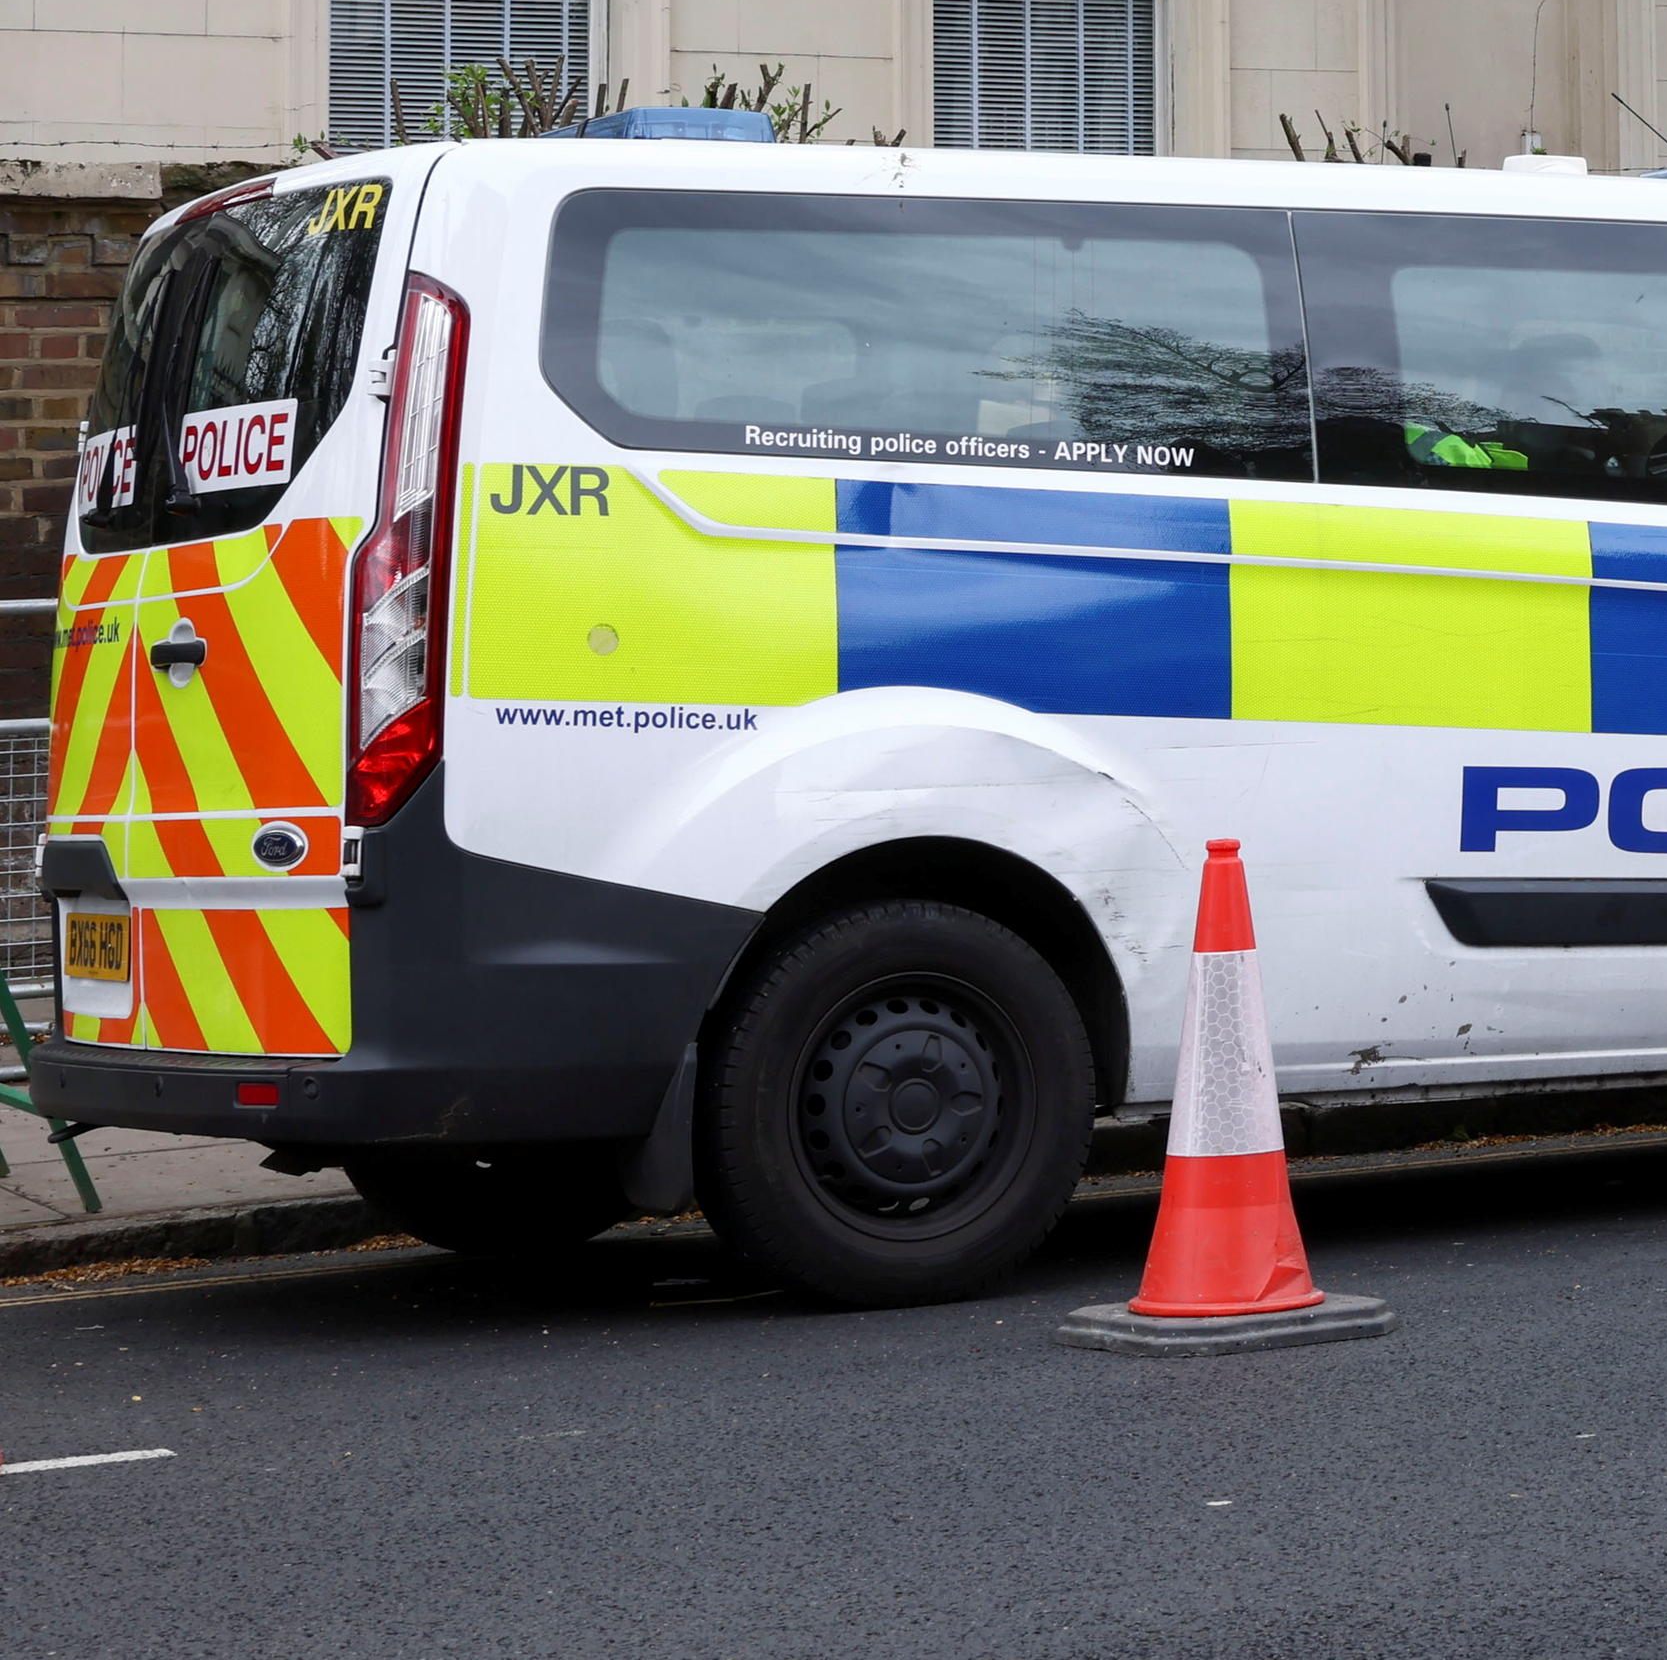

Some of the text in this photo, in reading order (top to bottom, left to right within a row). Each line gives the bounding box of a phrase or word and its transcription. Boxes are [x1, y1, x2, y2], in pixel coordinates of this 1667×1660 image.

[307, 184, 383, 236] JXR
[80, 437, 136, 504] POLCE
[180, 413, 289, 481] POLICE
[745, 425, 861, 455] Recruiting
[870, 433, 937, 455] police
[945, 436, 1030, 459] officers
[1054, 441, 1129, 464] APPLY
[1137, 445, 1194, 467] NOW
[490, 464, 610, 516] JXR
[495, 706, 758, 733] www.met.police.uk
[260, 836, 288, 856] Ford
